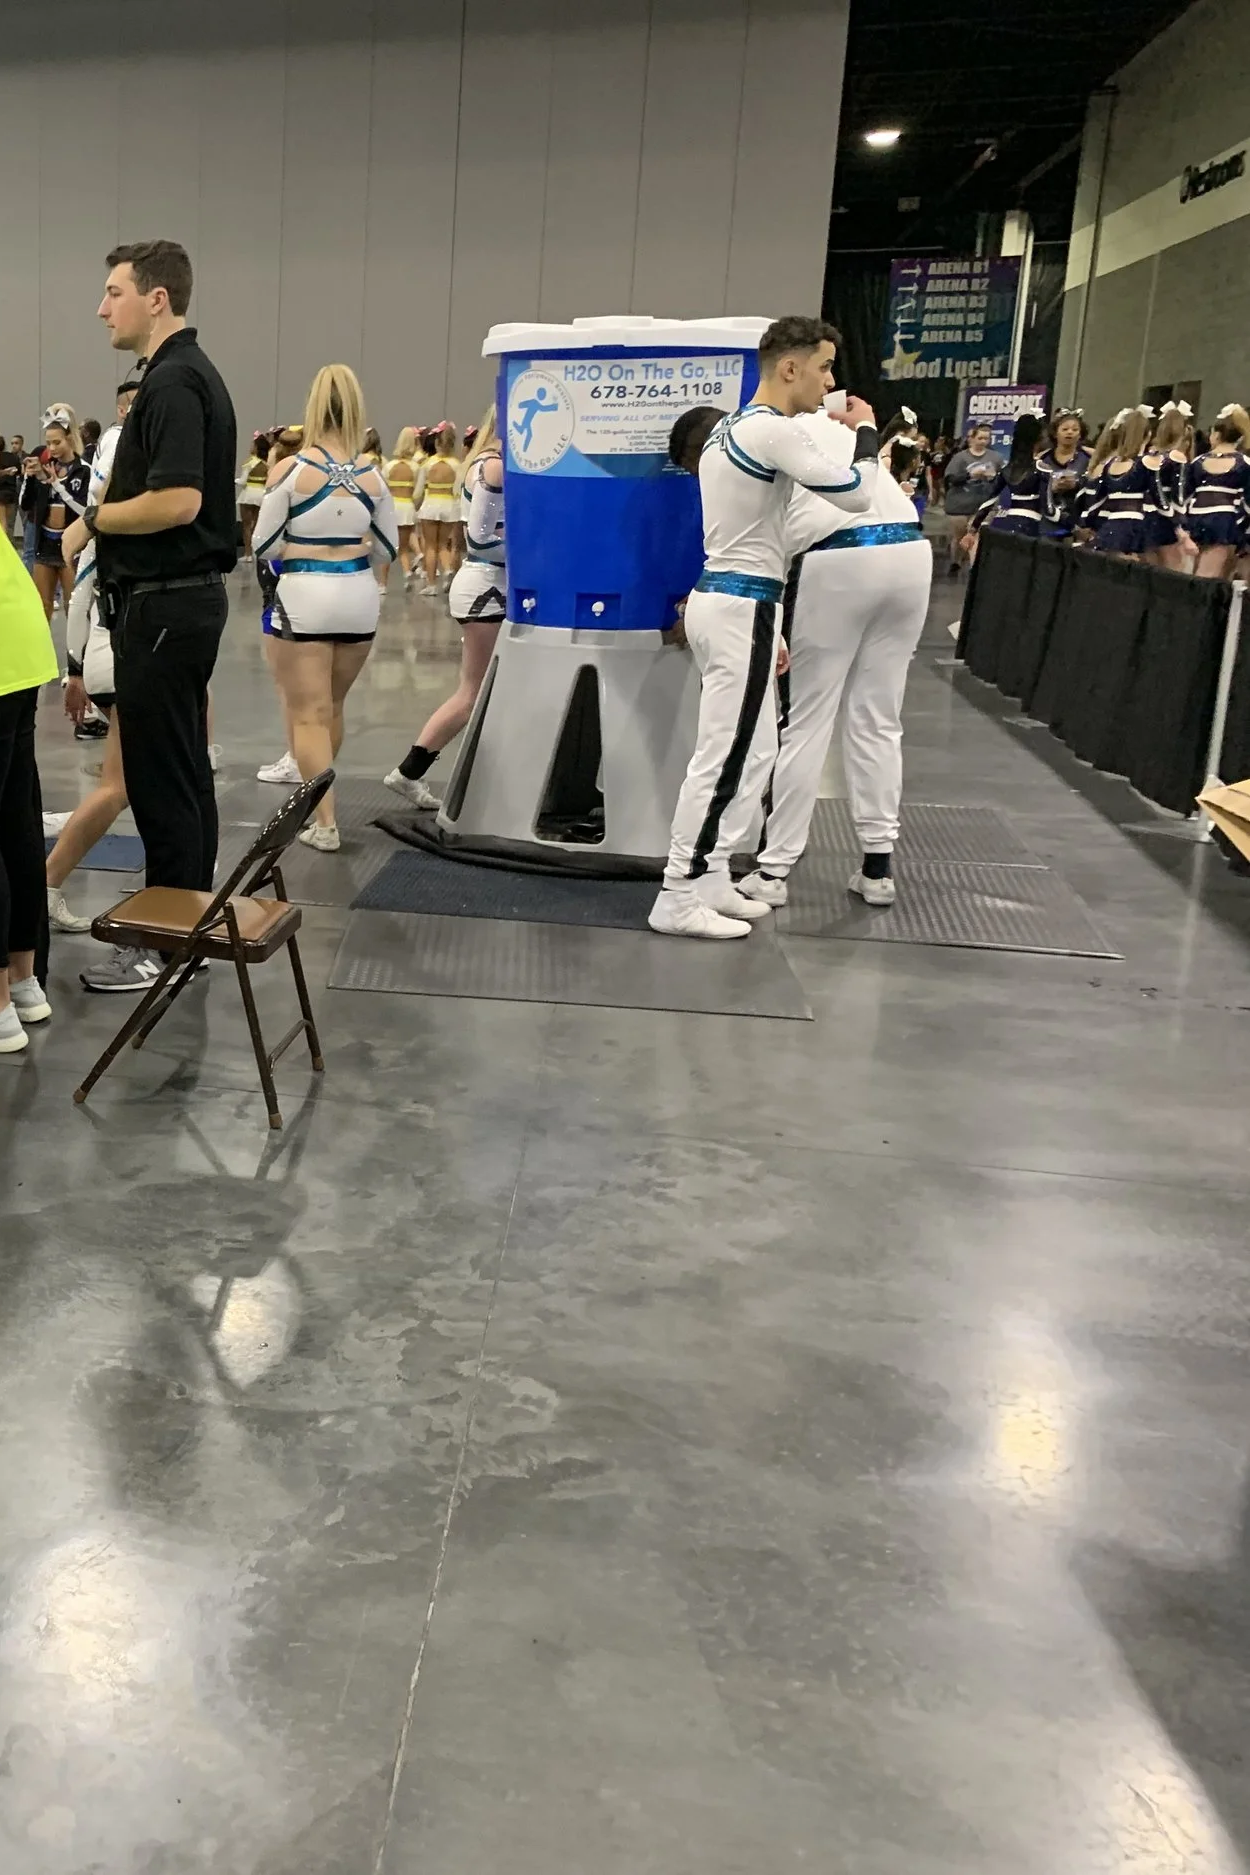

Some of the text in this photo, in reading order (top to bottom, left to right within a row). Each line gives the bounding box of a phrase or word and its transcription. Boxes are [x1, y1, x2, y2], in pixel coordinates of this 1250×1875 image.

[927, 260, 990, 275] ARENA B1
[925, 278, 990, 292] ARENA B2
[924, 297, 966, 310] ARENA
[922, 313, 964, 326] ARENA
[920, 330, 984, 343] ARENA B5
[608, 363, 635, 381] On
[641, 362, 674, 380] The
[680, 361, 709, 380] Go,
[715, 359, 741, 377] LLC
[890, 356, 1000, 380] Good Luck!
[590, 382, 723, 399] 678-764-1108
